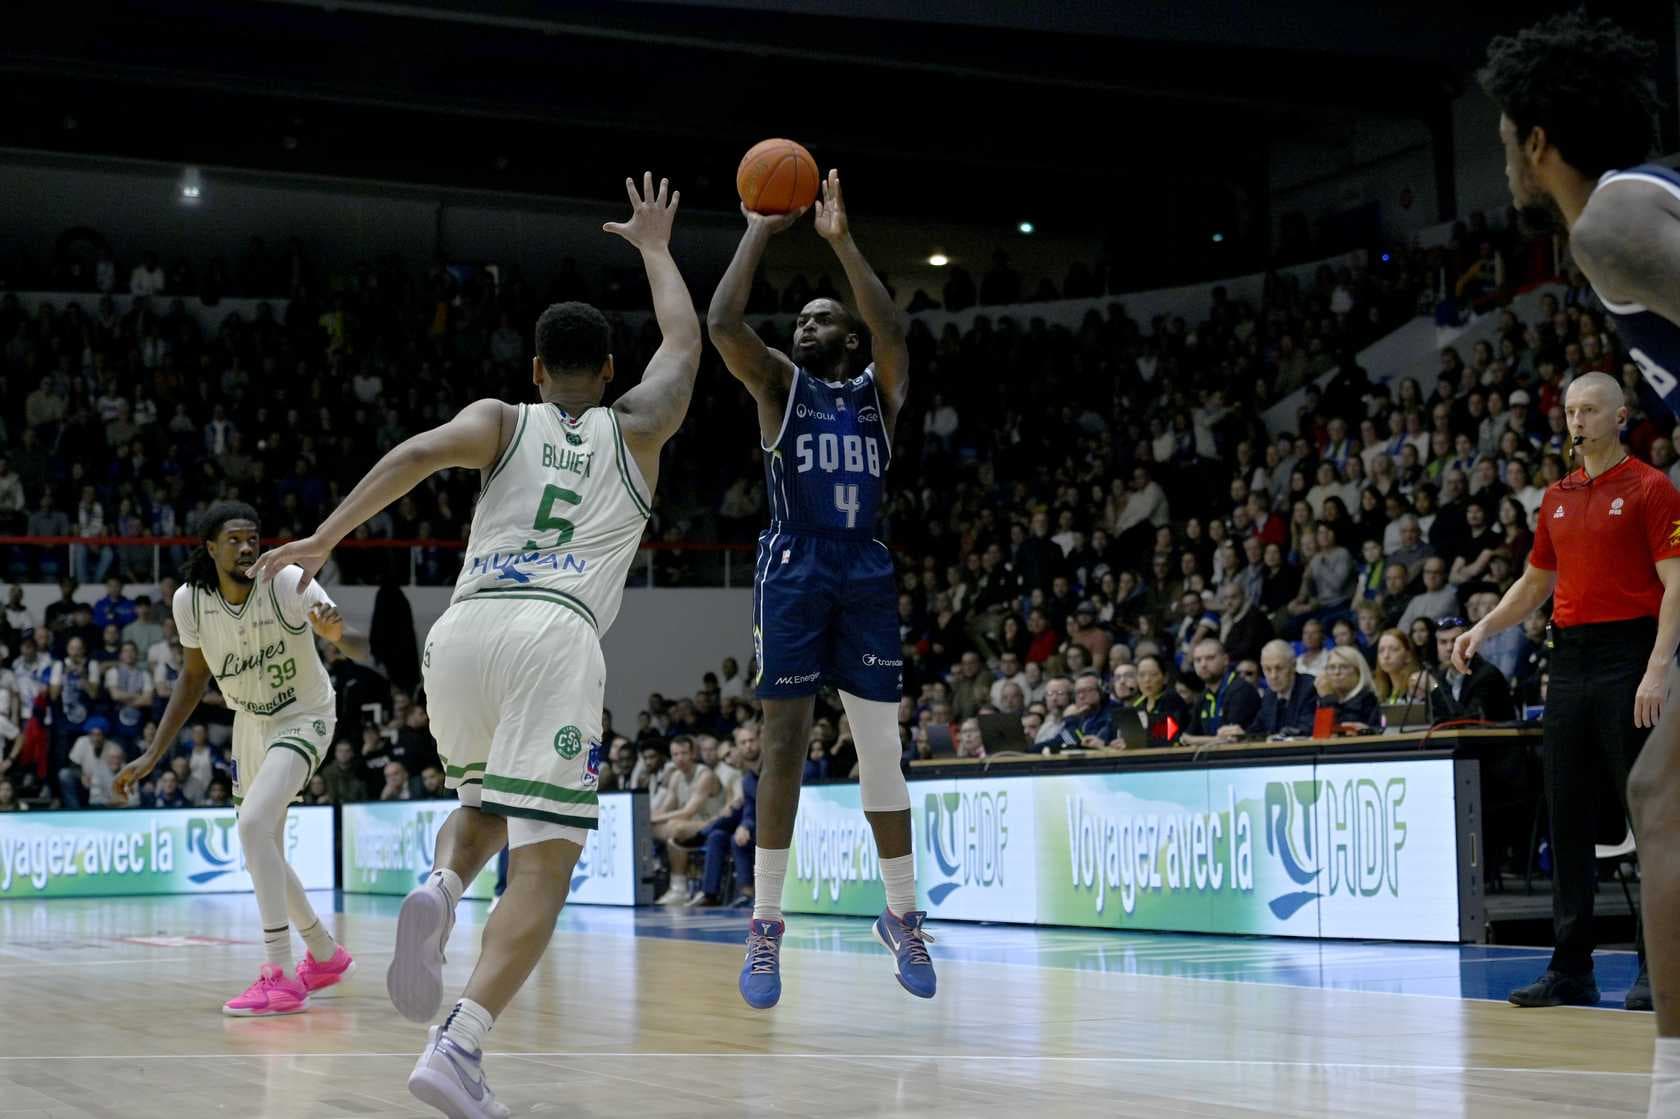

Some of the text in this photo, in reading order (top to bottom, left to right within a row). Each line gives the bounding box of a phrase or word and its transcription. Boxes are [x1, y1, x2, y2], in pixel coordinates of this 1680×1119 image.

[542, 442, 594, 478] BLUIET
[796, 433, 880, 478] SQBB
[520, 483, 583, 552] 5
[834, 484, 860, 528] 4
[469, 552, 587, 575] HUMAN
[267, 657, 297, 689] 39
[0, 837, 76, 891] yagez
[83, 829, 144, 874] avec
[151, 816, 173, 873] la
[1066, 795, 1161, 914] Voyagez
[1165, 812, 1222, 890] avec
[1229, 784, 1254, 891] la
